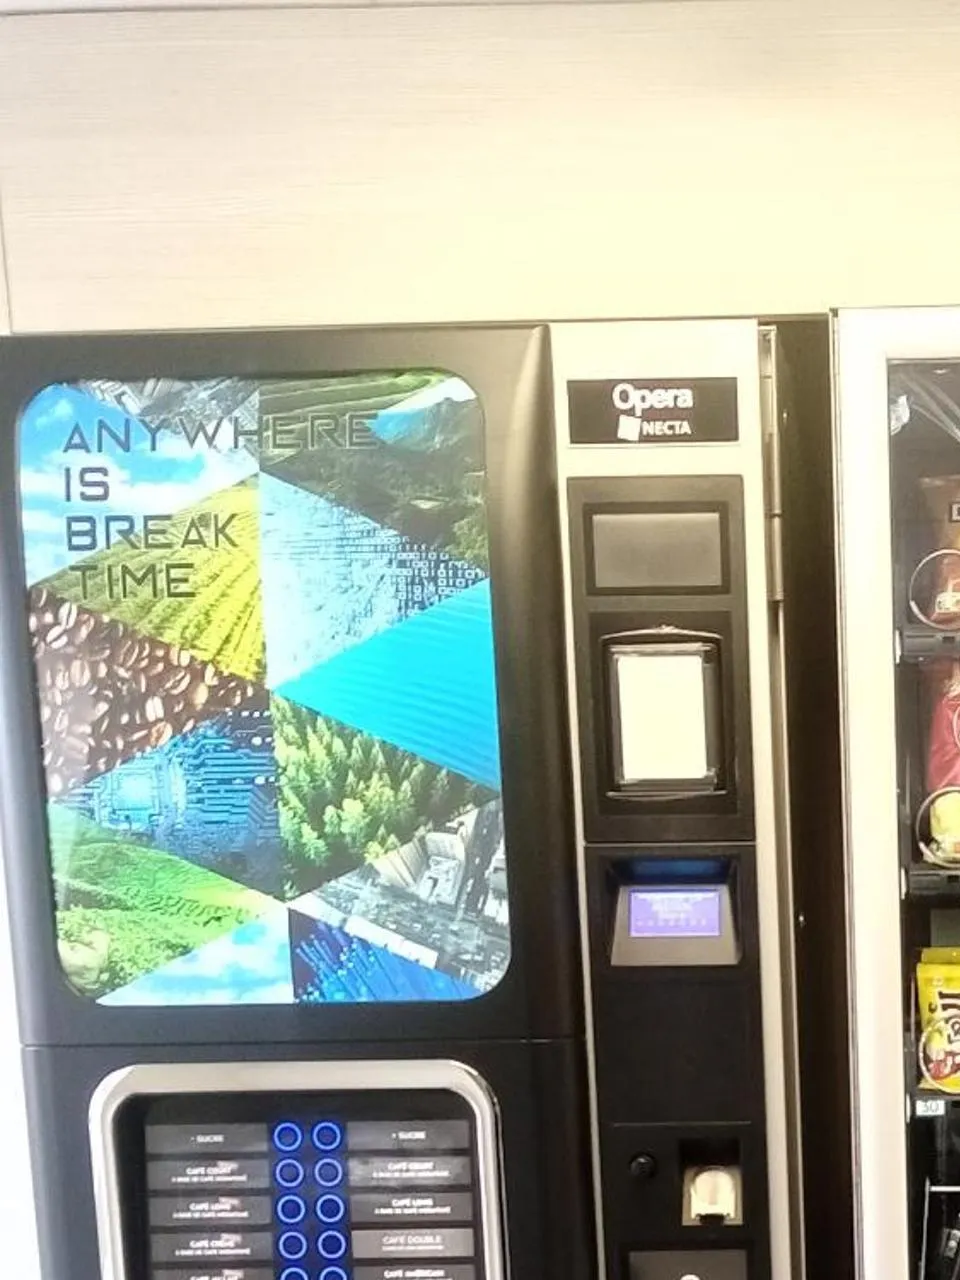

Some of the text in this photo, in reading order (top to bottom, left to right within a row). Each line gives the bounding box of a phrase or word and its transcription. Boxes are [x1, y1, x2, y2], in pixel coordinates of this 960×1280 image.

[612, 383, 693, 416] Opera
[63, 413, 380, 453] ANYWHERE
[642, 420, 691, 435] NECTA
[65, 467, 110, 502] IS
[66, 513, 239, 551] BREAK
[70, 563, 196, 600] TIME
